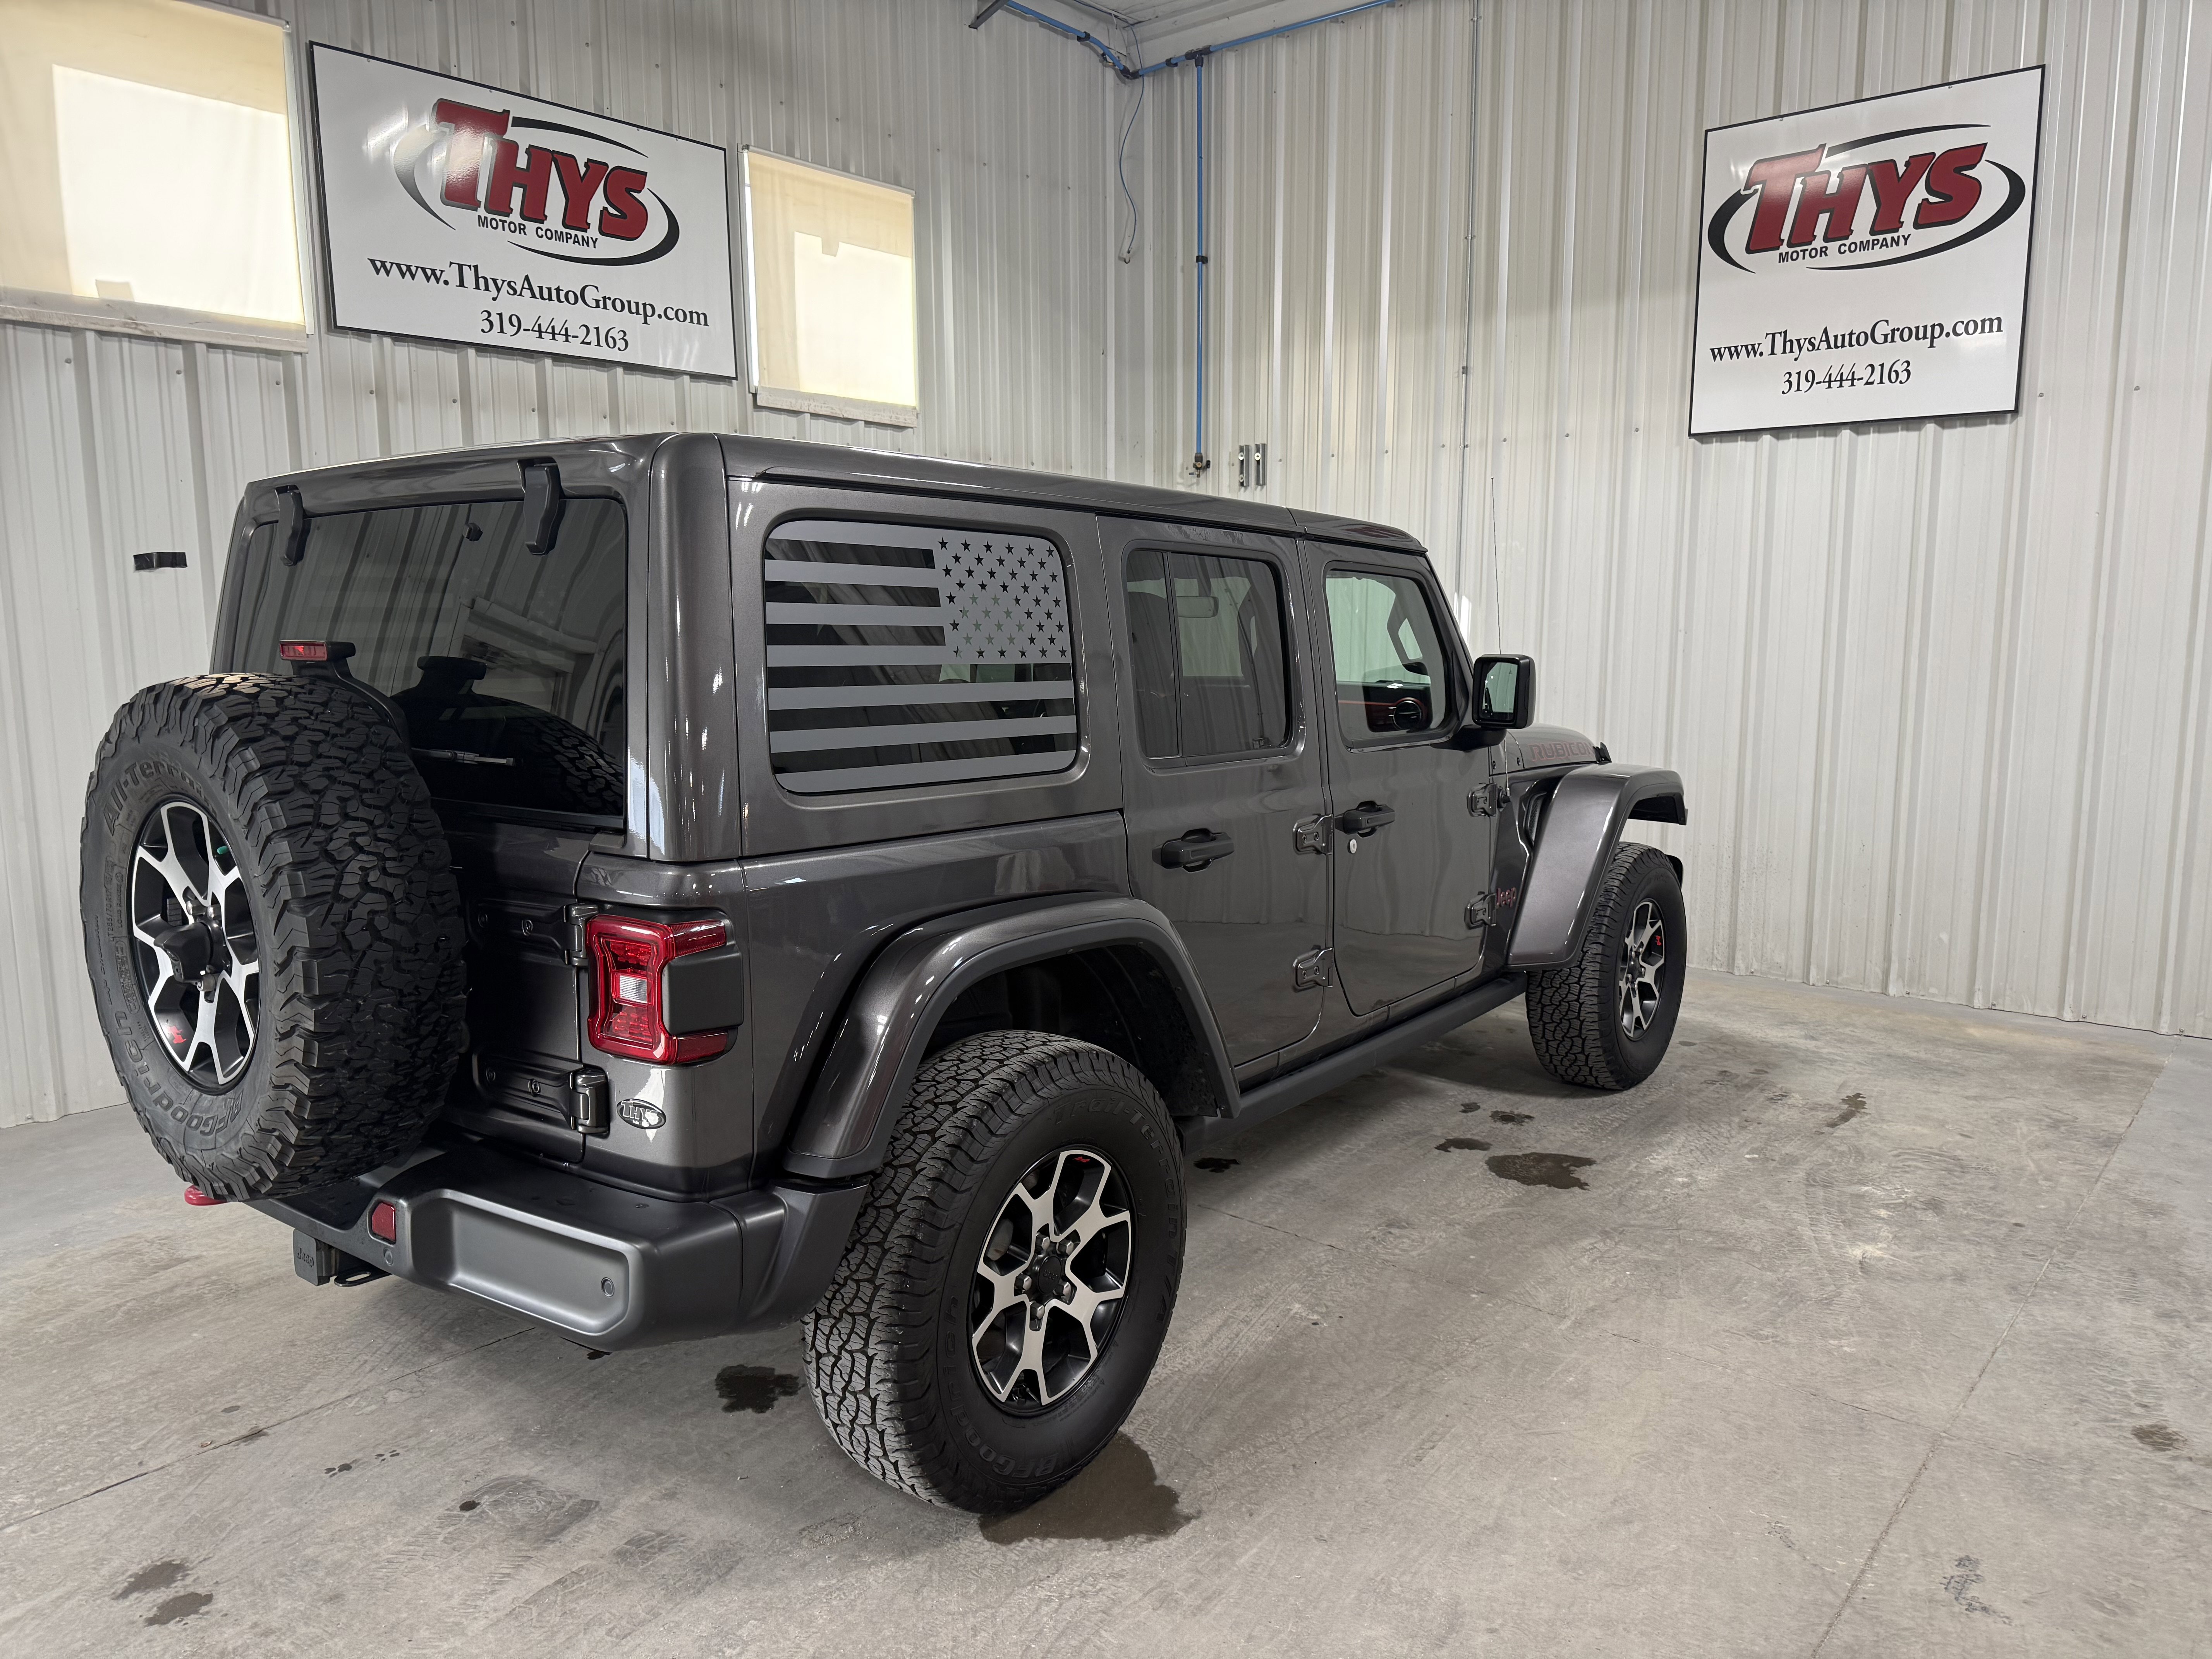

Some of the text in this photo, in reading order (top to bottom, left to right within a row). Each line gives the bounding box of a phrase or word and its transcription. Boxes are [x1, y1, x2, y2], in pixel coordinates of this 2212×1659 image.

[427, 98, 648, 241] THYS
[1741, 143, 1988, 254] THYS
[477, 215, 598, 249] MOTOR COMPANY
[1778, 234, 1911, 264] MOTOR COMPANY
[367, 258, 709, 326] www.ThysAutoGroup.com
[480, 310, 629, 351] 319-444-2163
[1709, 315, 2003, 362] www.ThysAutoGroup.com
[1781, 359, 1911, 395] 319-444-2163
[1528, 741, 1595, 761] RUBICON
[1495, 887, 1516, 909] Jeep
[115, 1011, 244, 1136] BFGoodrich
[943, 1295, 1059, 1478] BFGoodrich
